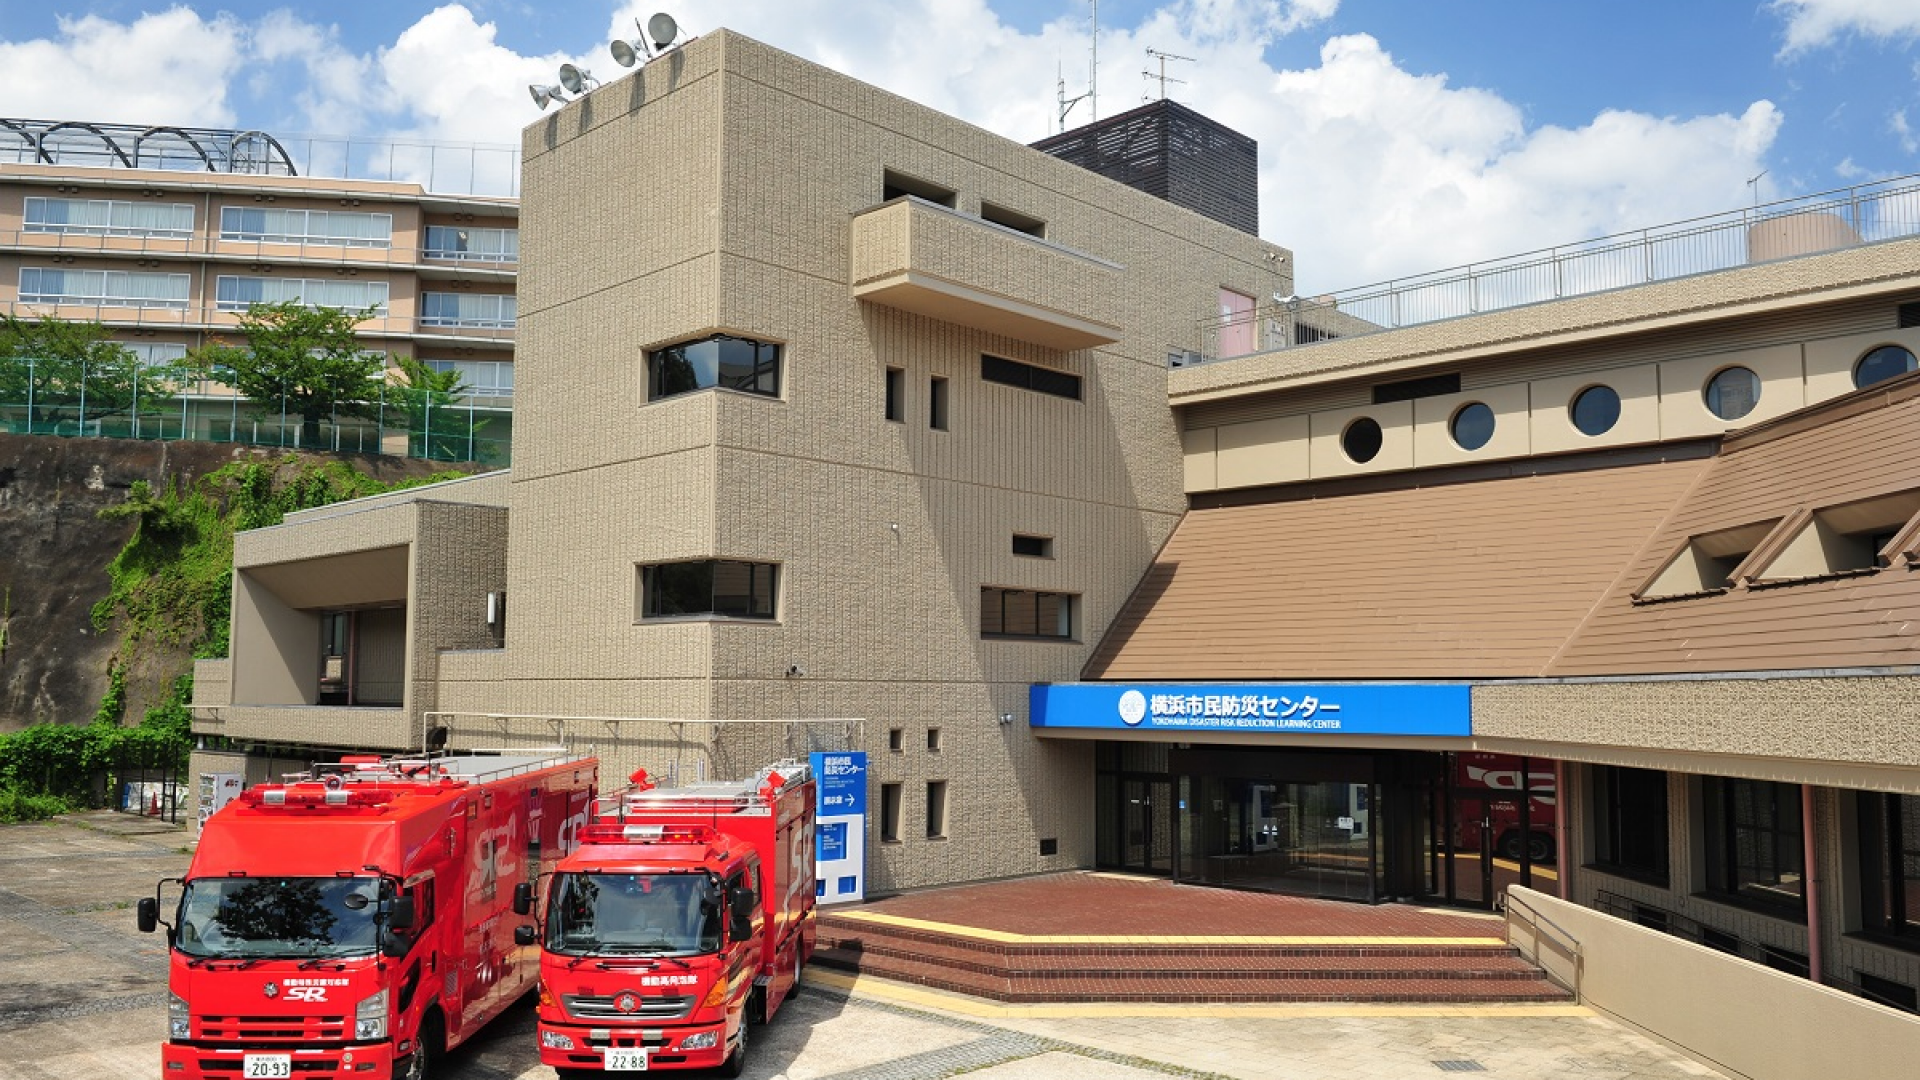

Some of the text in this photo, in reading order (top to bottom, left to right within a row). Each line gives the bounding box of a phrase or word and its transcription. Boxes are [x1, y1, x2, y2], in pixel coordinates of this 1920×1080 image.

[1151, 694, 1340, 717] 横浜市民防災センター
[1152, 717, 1341, 729] YOKOHAMA DISASTER RISK REDUCTION LEARNING CENTER
[283, 986, 328, 1002] SR
[252, 1062, 289, 1076] 20-93
